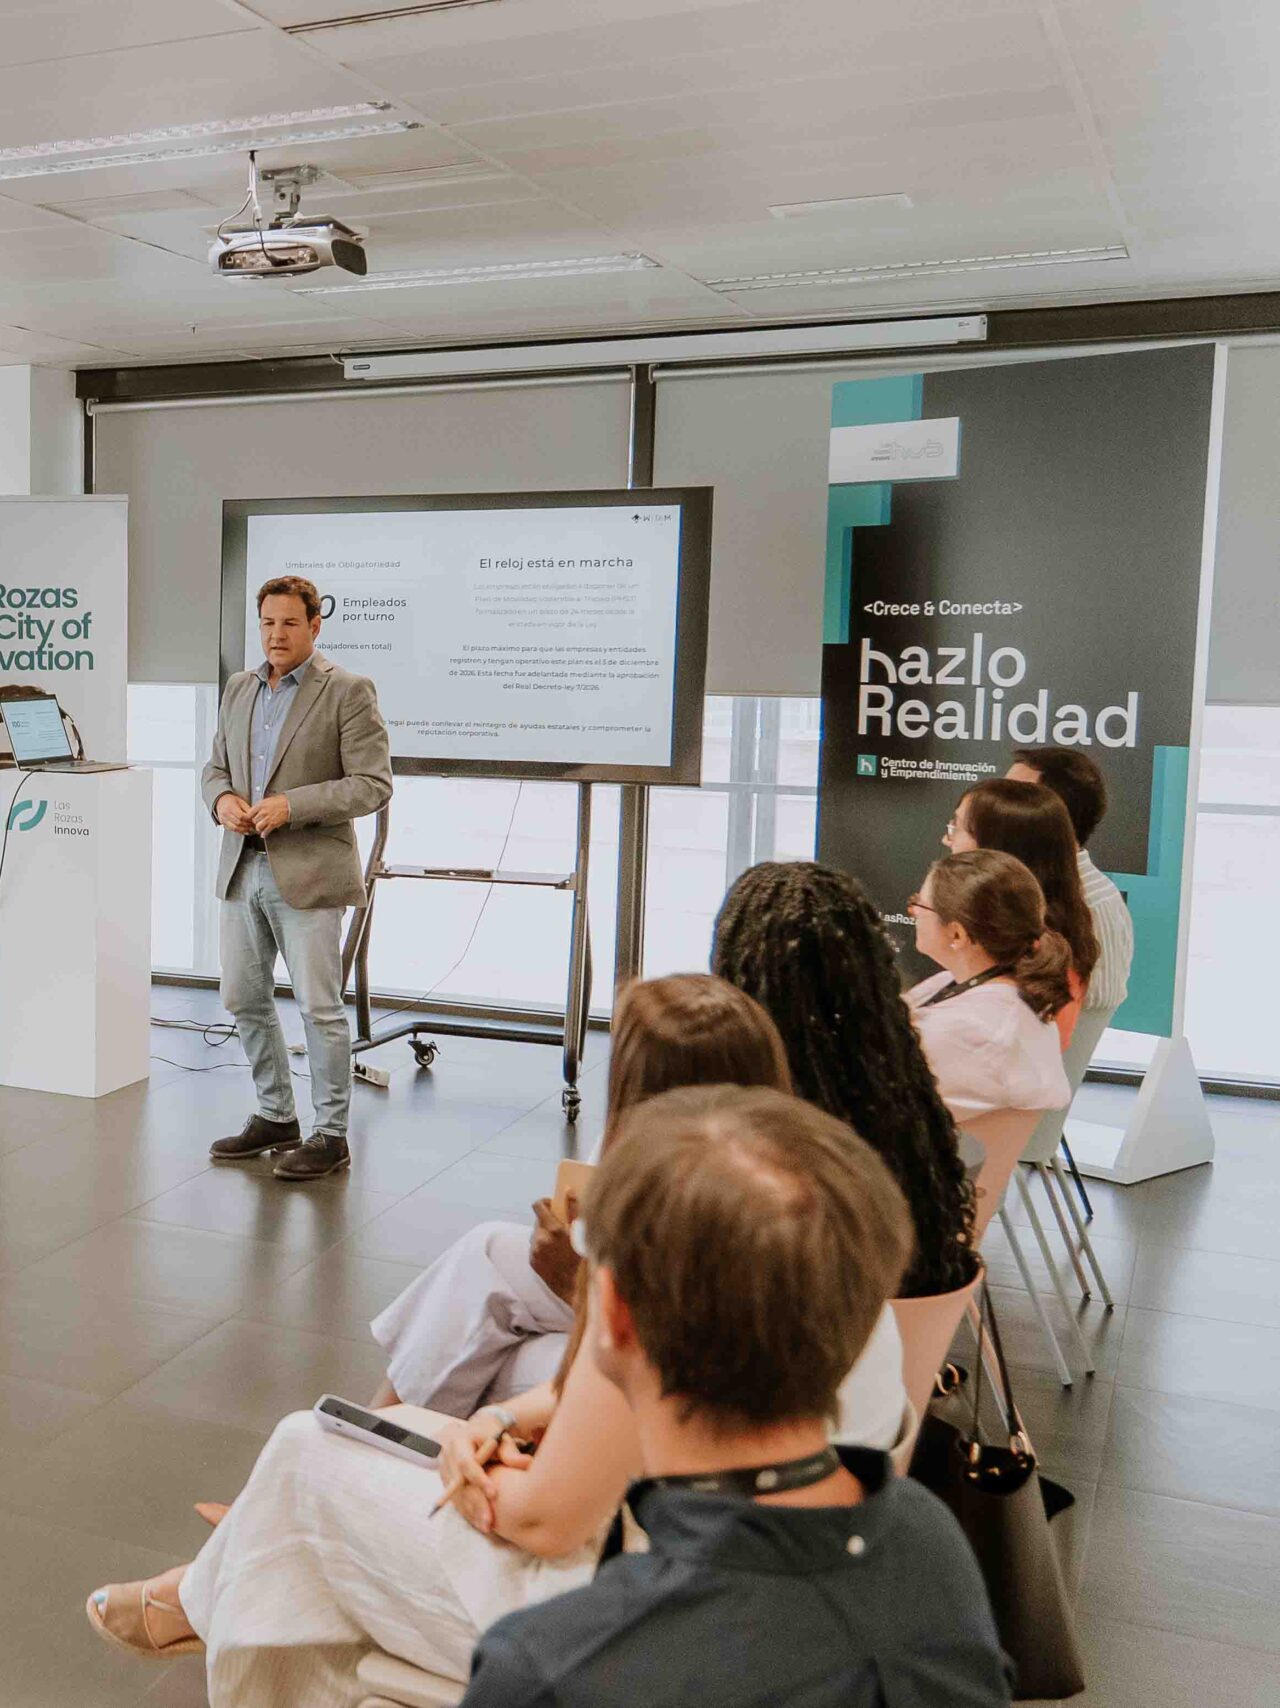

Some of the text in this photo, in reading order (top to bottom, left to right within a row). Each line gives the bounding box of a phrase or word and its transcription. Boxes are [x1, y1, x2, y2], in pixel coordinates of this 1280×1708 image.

[285, 560, 401, 570] Umbrales de Obligatoriedad
[479, 556, 634, 570] El reloj está en marcha
[342, 597, 407, 609] Empleados
[863, 600, 1023, 616] <Crece & Conecta>
[342, 612, 395, 622] por turno
[62, 612, 92, 640] of
[314, 642, 358, 651] rabajadores
[860, 632, 1027, 688] hazlo
[858, 684, 1139, 748] Realidad
[417, 729, 457, 737] reputación
[880, 756, 996, 773] Centro de Innovación
[881, 767, 978, 782] y Emprendimiento
[54, 800, 71, 810] Las
[54, 812, 84, 824] Rozas
[54, 825, 90, 836] Innova
